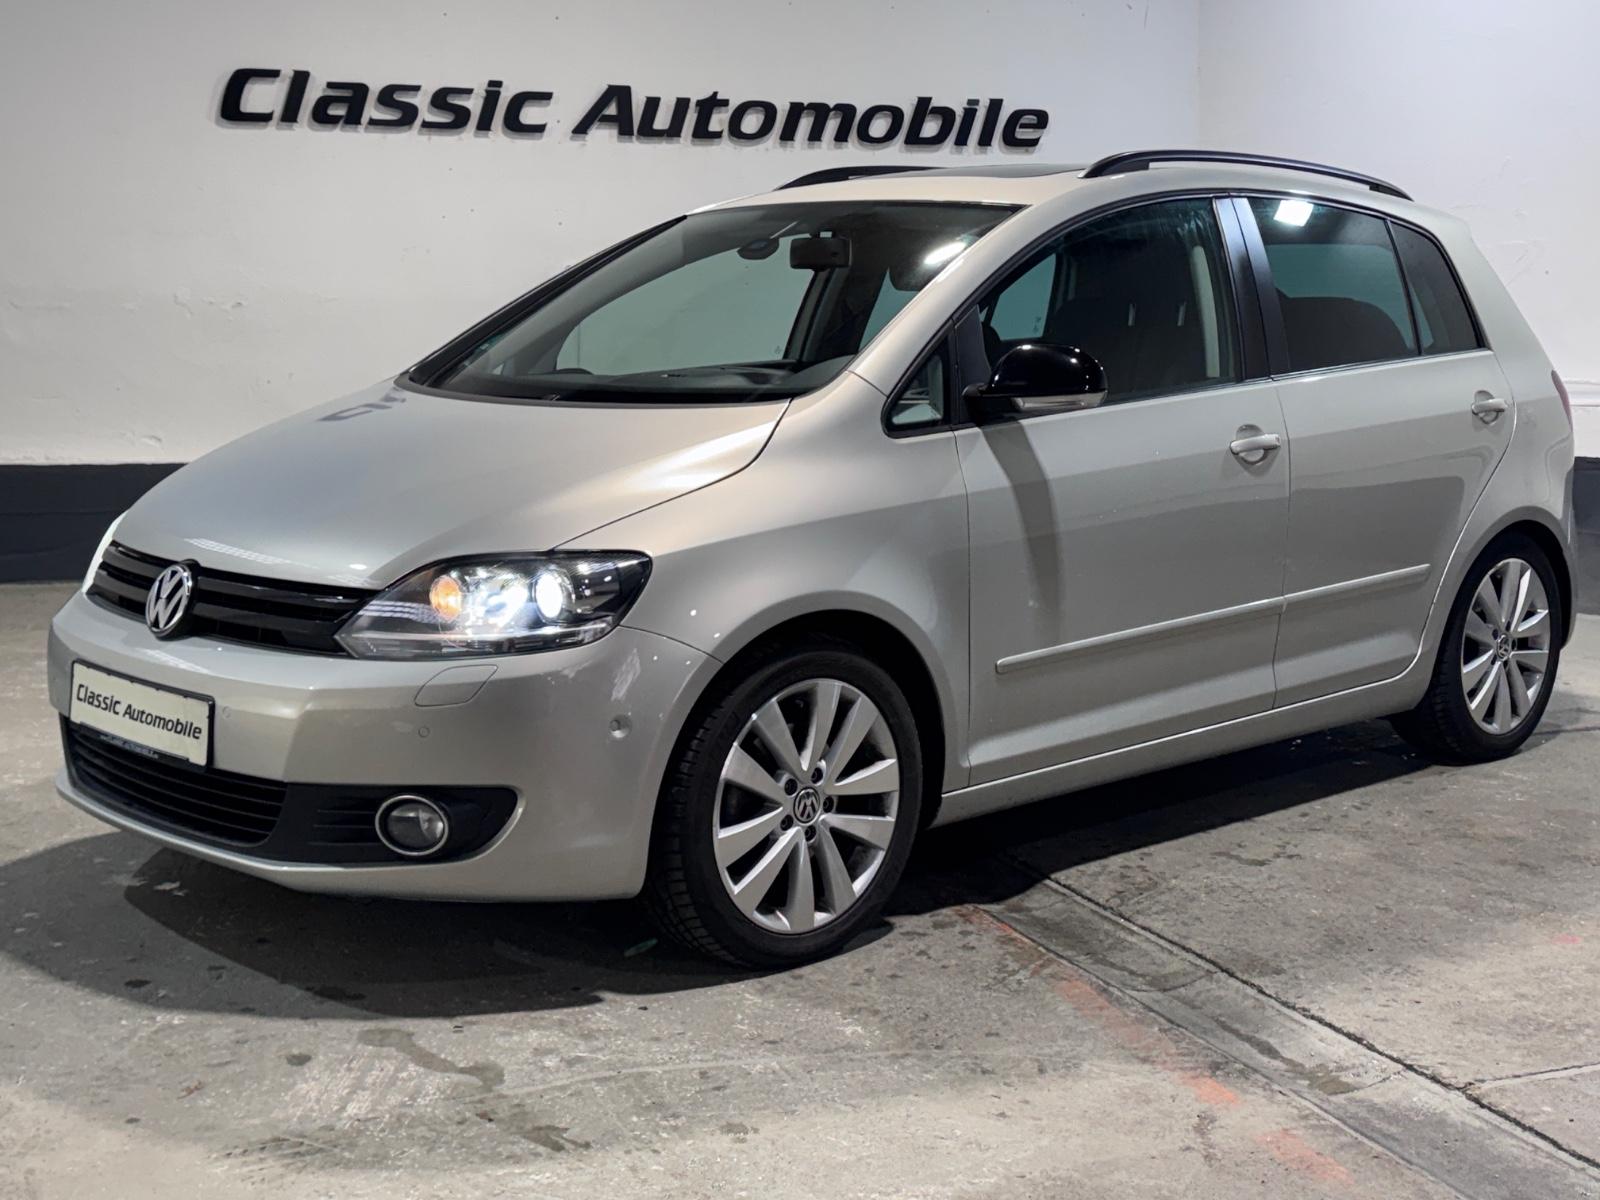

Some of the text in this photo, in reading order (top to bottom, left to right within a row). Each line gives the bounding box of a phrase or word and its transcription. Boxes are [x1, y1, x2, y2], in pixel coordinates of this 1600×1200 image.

[220, 68, 1049, 149] Classic Automobile
[146, 565, 192, 635] VW
[76, 684, 203, 740] Classic Automobile
